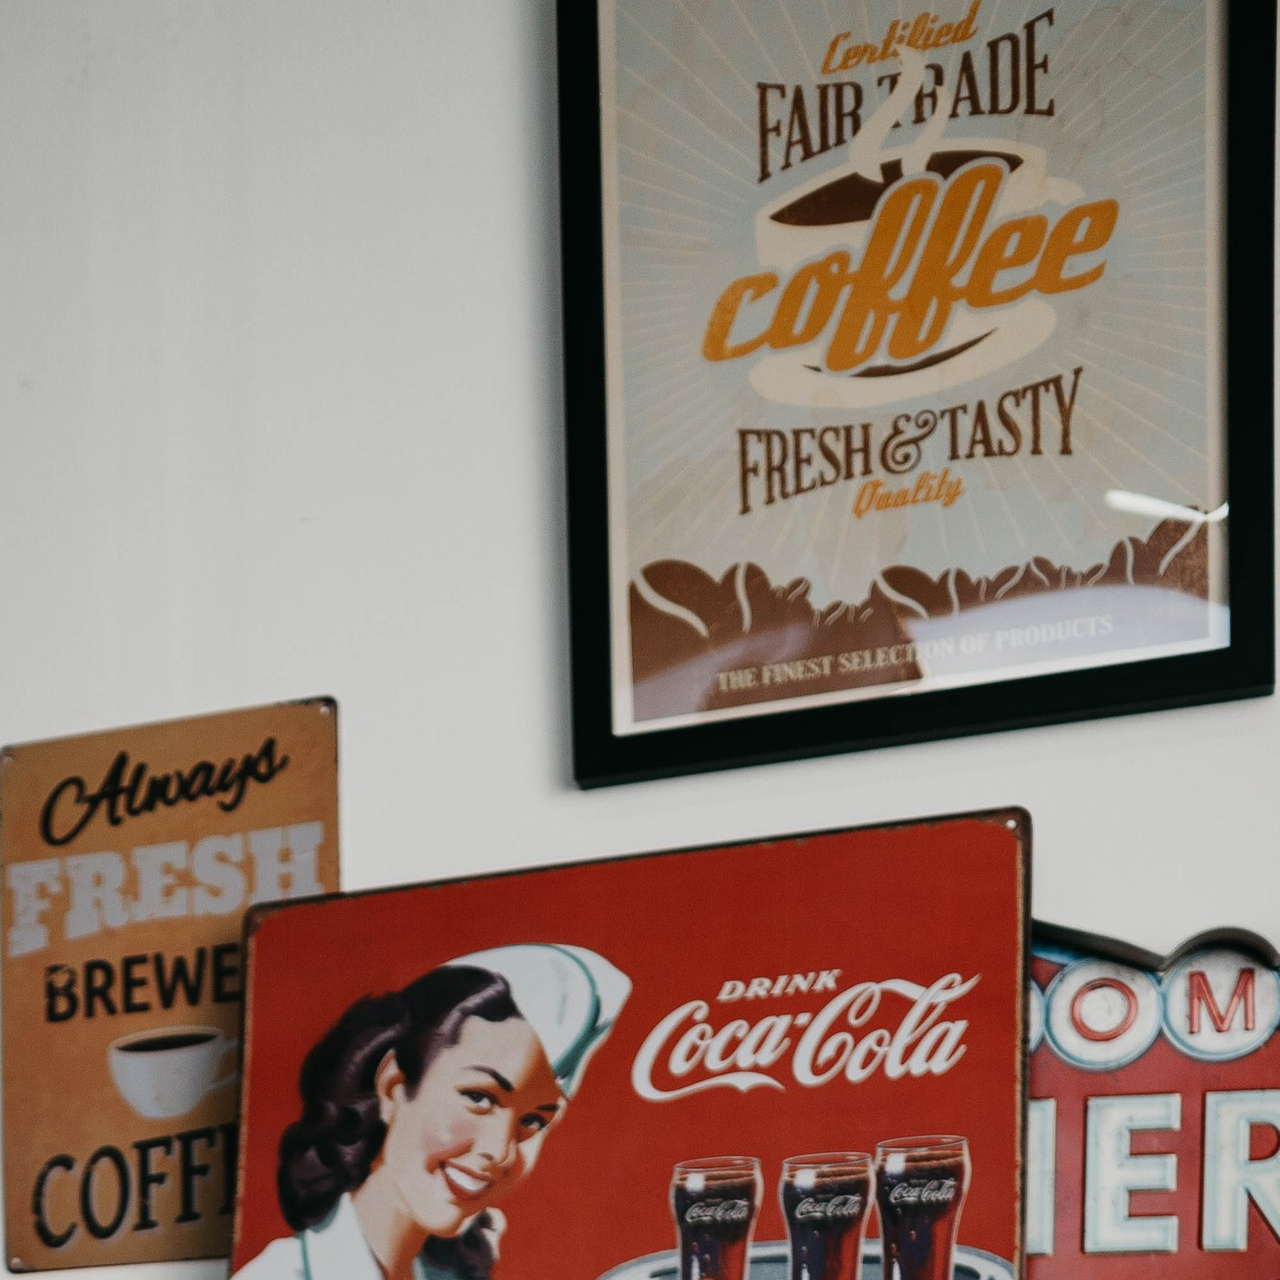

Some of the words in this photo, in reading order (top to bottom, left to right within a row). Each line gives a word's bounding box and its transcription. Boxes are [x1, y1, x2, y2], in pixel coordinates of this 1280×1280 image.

[756, 80, 866, 184] FAIR
[702, 164, 1118, 372] coffee
[737, 422, 874, 516] FRESH
[880, 408, 939, 475] &
[939, 366, 1084, 462] TASTY
[852, 466, 966, 520] Quality
[715, 668, 758, 693] THE
[761, 655, 833, 687] FINEST
[837, 634, 956, 672] SELECTION
[958, 631, 989, 654] OF
[994, 613, 1114, 650] PRODUCTS
[39, 736, 290, 847] Always
[6, 820, 325, 958] FRESH
[45, 943, 244, 1023] BREWE
[716, 968, 844, 1003] DRINK
[631, 972, 983, 1103] Coca-Cola
